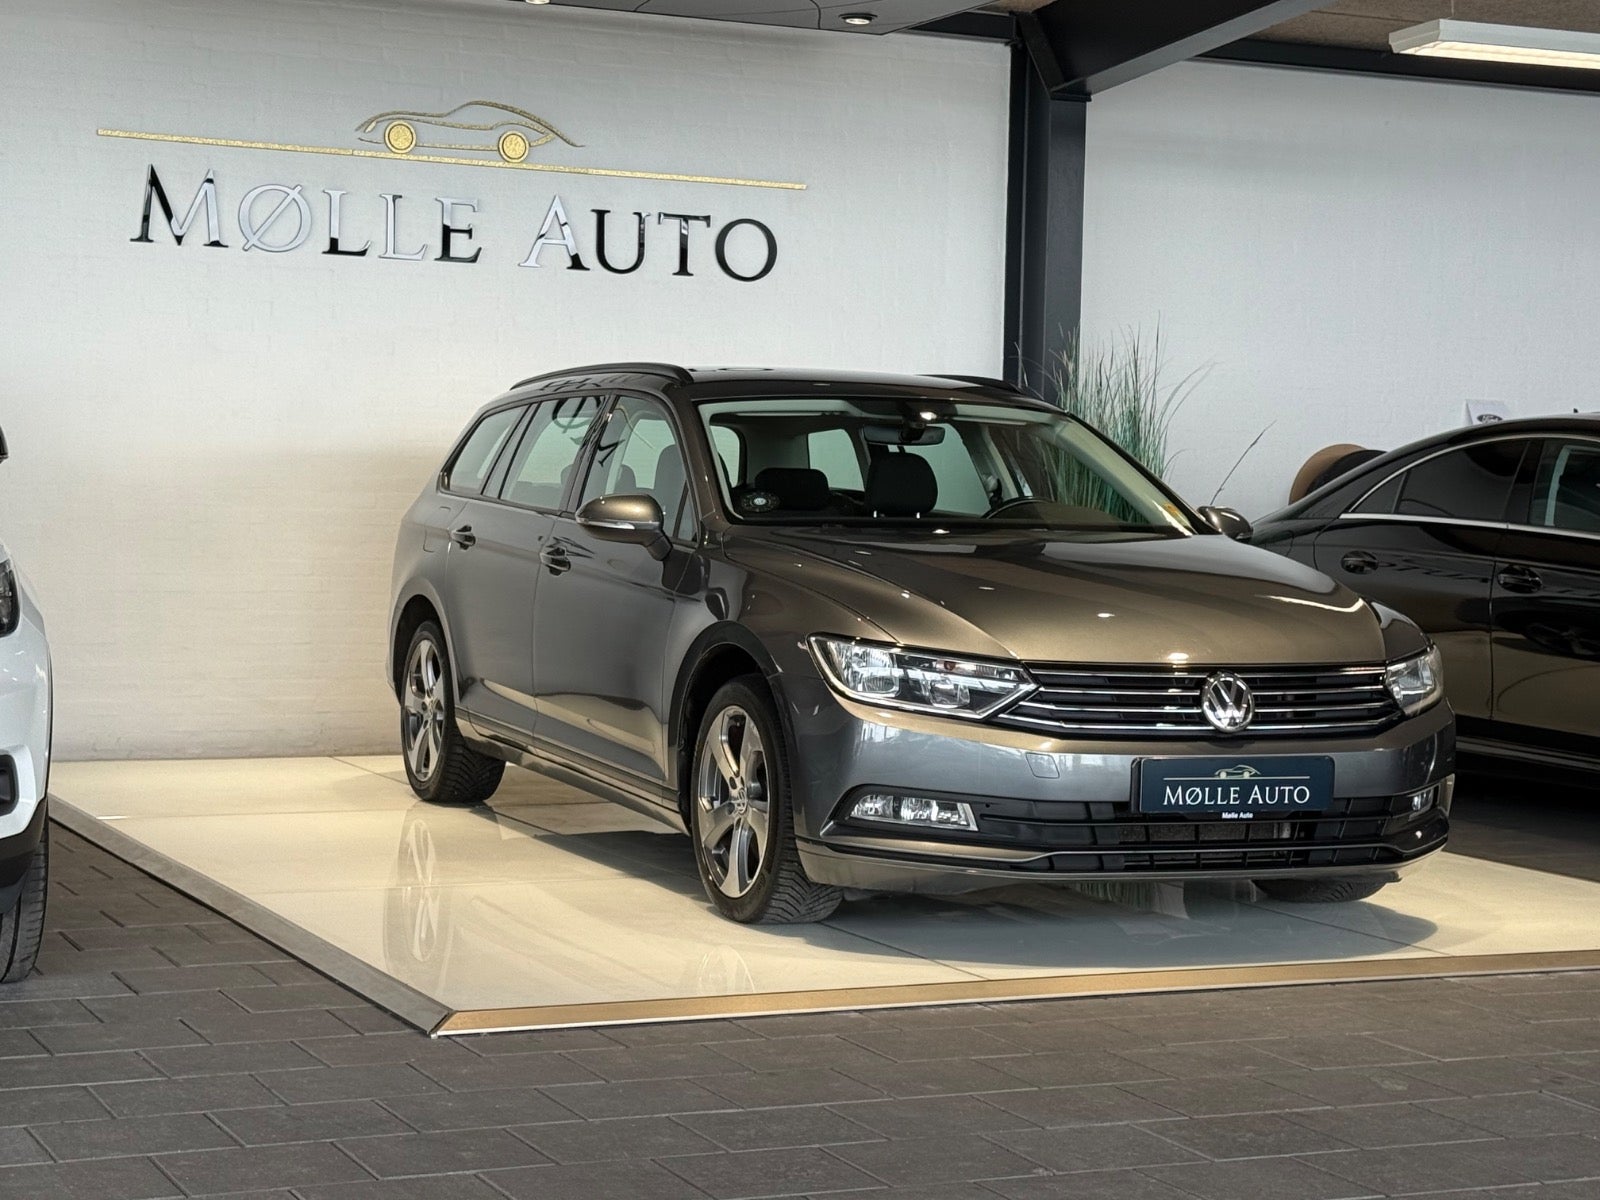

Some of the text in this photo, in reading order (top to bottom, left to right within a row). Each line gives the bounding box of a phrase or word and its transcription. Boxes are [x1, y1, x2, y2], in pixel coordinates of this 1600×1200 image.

[130, 163, 778, 283] MØLLE AUTO
[1163, 785, 1310, 806] MØLLE AUTO
[1239, 811, 1254, 819] Auto
